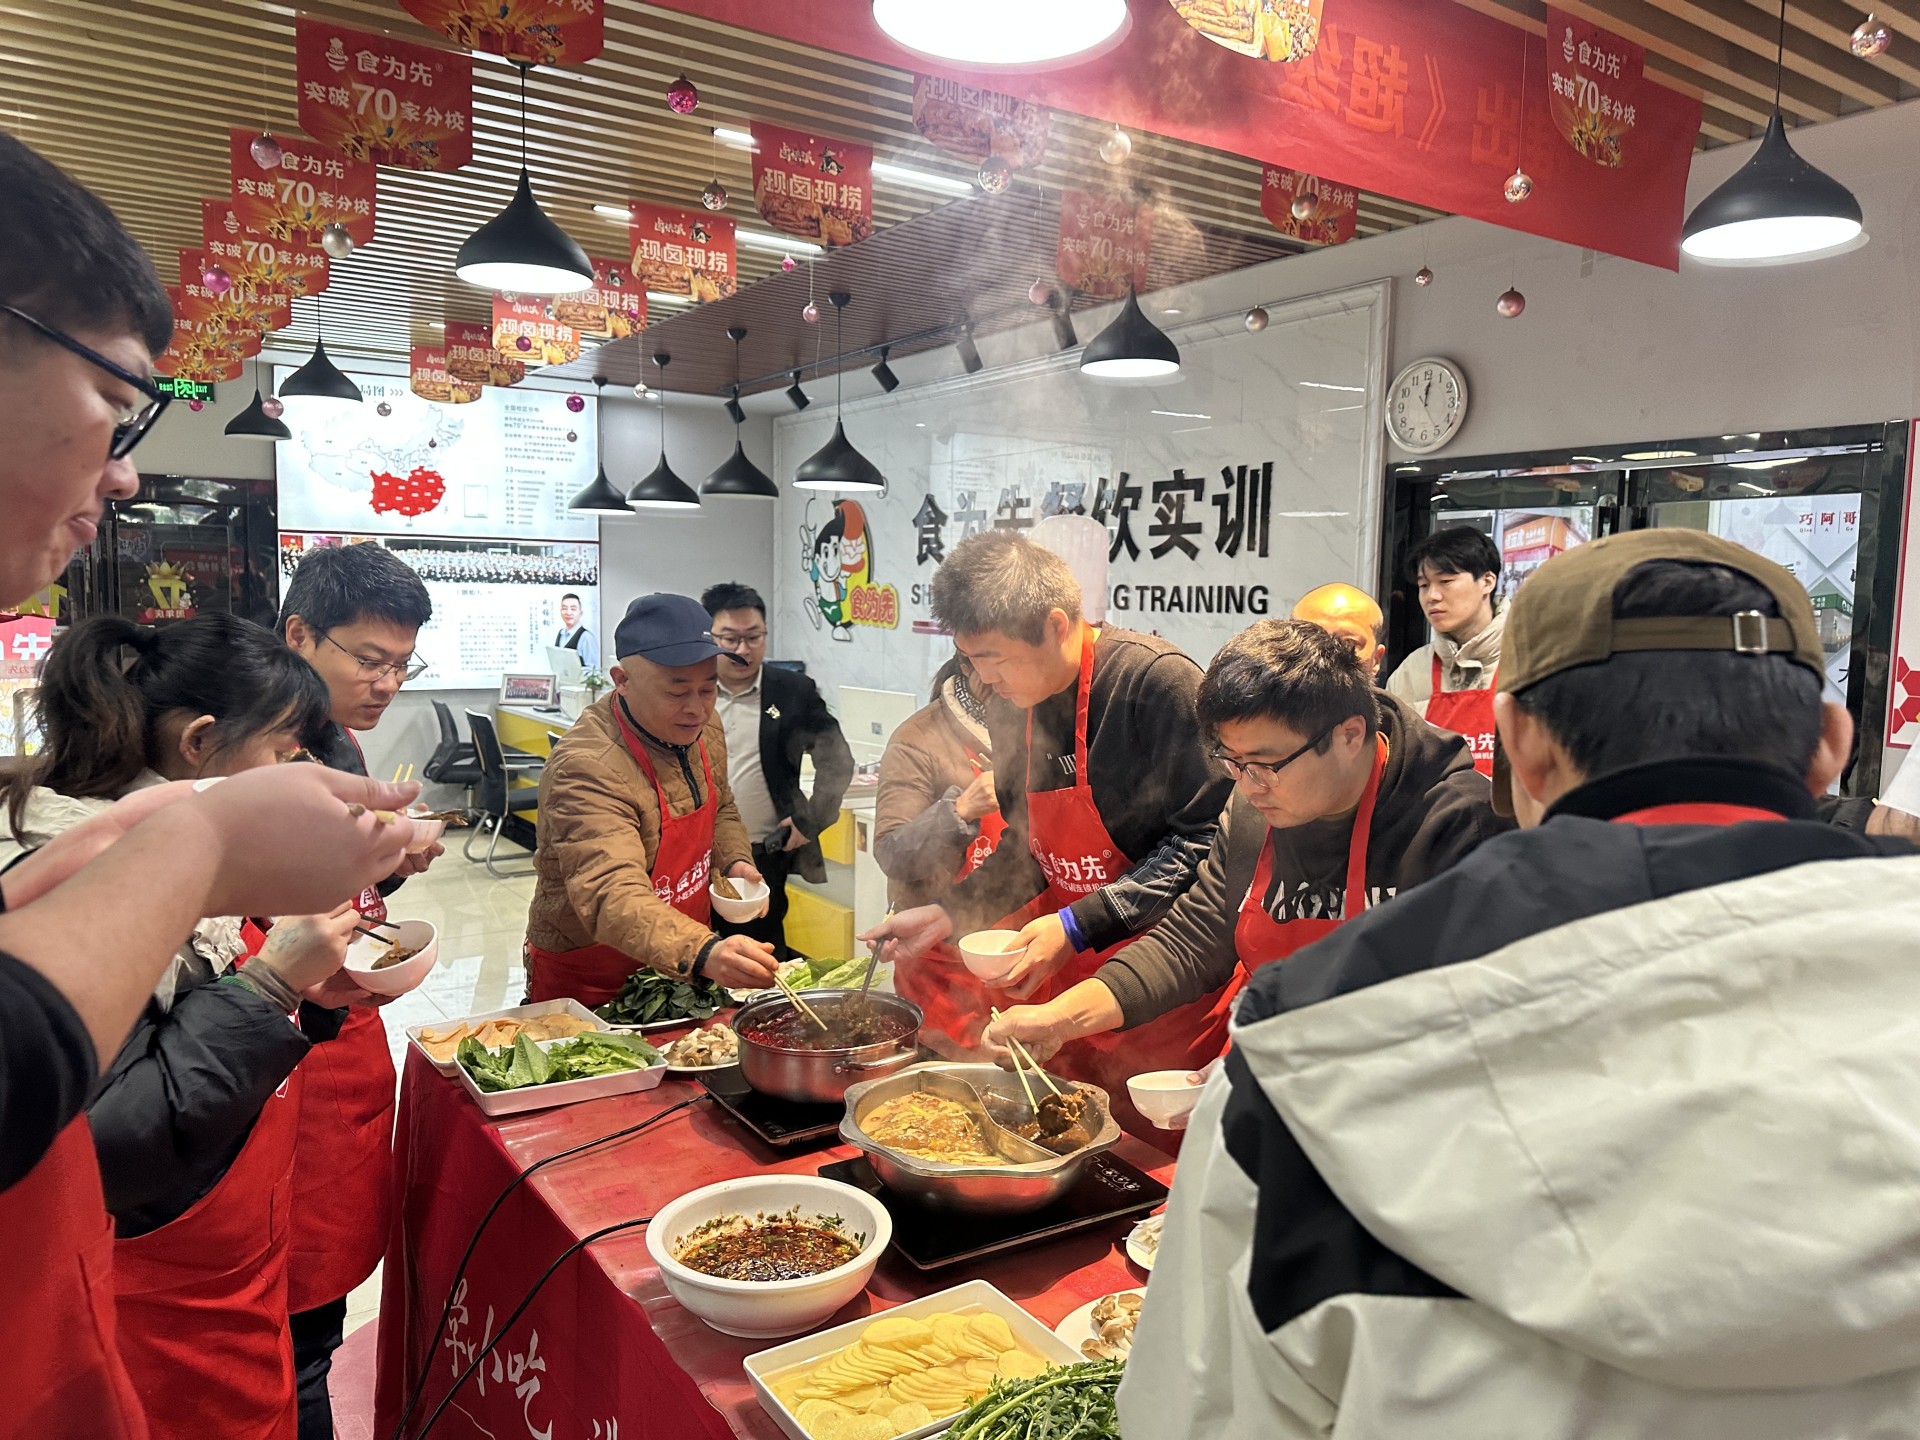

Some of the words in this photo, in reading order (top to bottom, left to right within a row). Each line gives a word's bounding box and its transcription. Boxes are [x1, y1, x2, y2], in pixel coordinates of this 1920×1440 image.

[355, 49, 433, 87] 食为先
[1578, 40, 1620, 79] 食为先
[304, 80, 465, 132] 突破70家分校
[1552, 71, 1636, 127] 突破70家分校
[281, 151, 344, 179] 食为先
[237, 177, 370, 216] 突破70家分校
[763, 167, 862, 211] 现卤现捞
[1266, 169, 1355, 209] 突破70家分校
[1094, 210, 1134, 235] 食为先
[209, 240, 325, 269] 突破70家分校
[640, 238, 728, 272] 现卤现捞
[1062, 236, 1146, 267] 突破70家分校
[500, 317, 574, 343] 现卤现捞
[1412, 375, 1419, 386] 11
[1424, 369, 1433, 381] 12
[1438, 372, 1442, 384] 1
[1445, 381, 1453, 394] 2
[1401, 387, 1410, 399] 10
[1447, 397, 1455, 408] 3
[1397, 402, 1405, 414] 9
[1444, 413, 1450, 424] 4
[1399, 416, 1407, 428] 8
[1407, 427, 1415, 439] 7
[1420, 429, 1428, 441] 6
[1433, 425, 1440, 437] 5
[851, 585, 894, 624] 食为先
[1135, 584, 1270, 615] TRAINING
